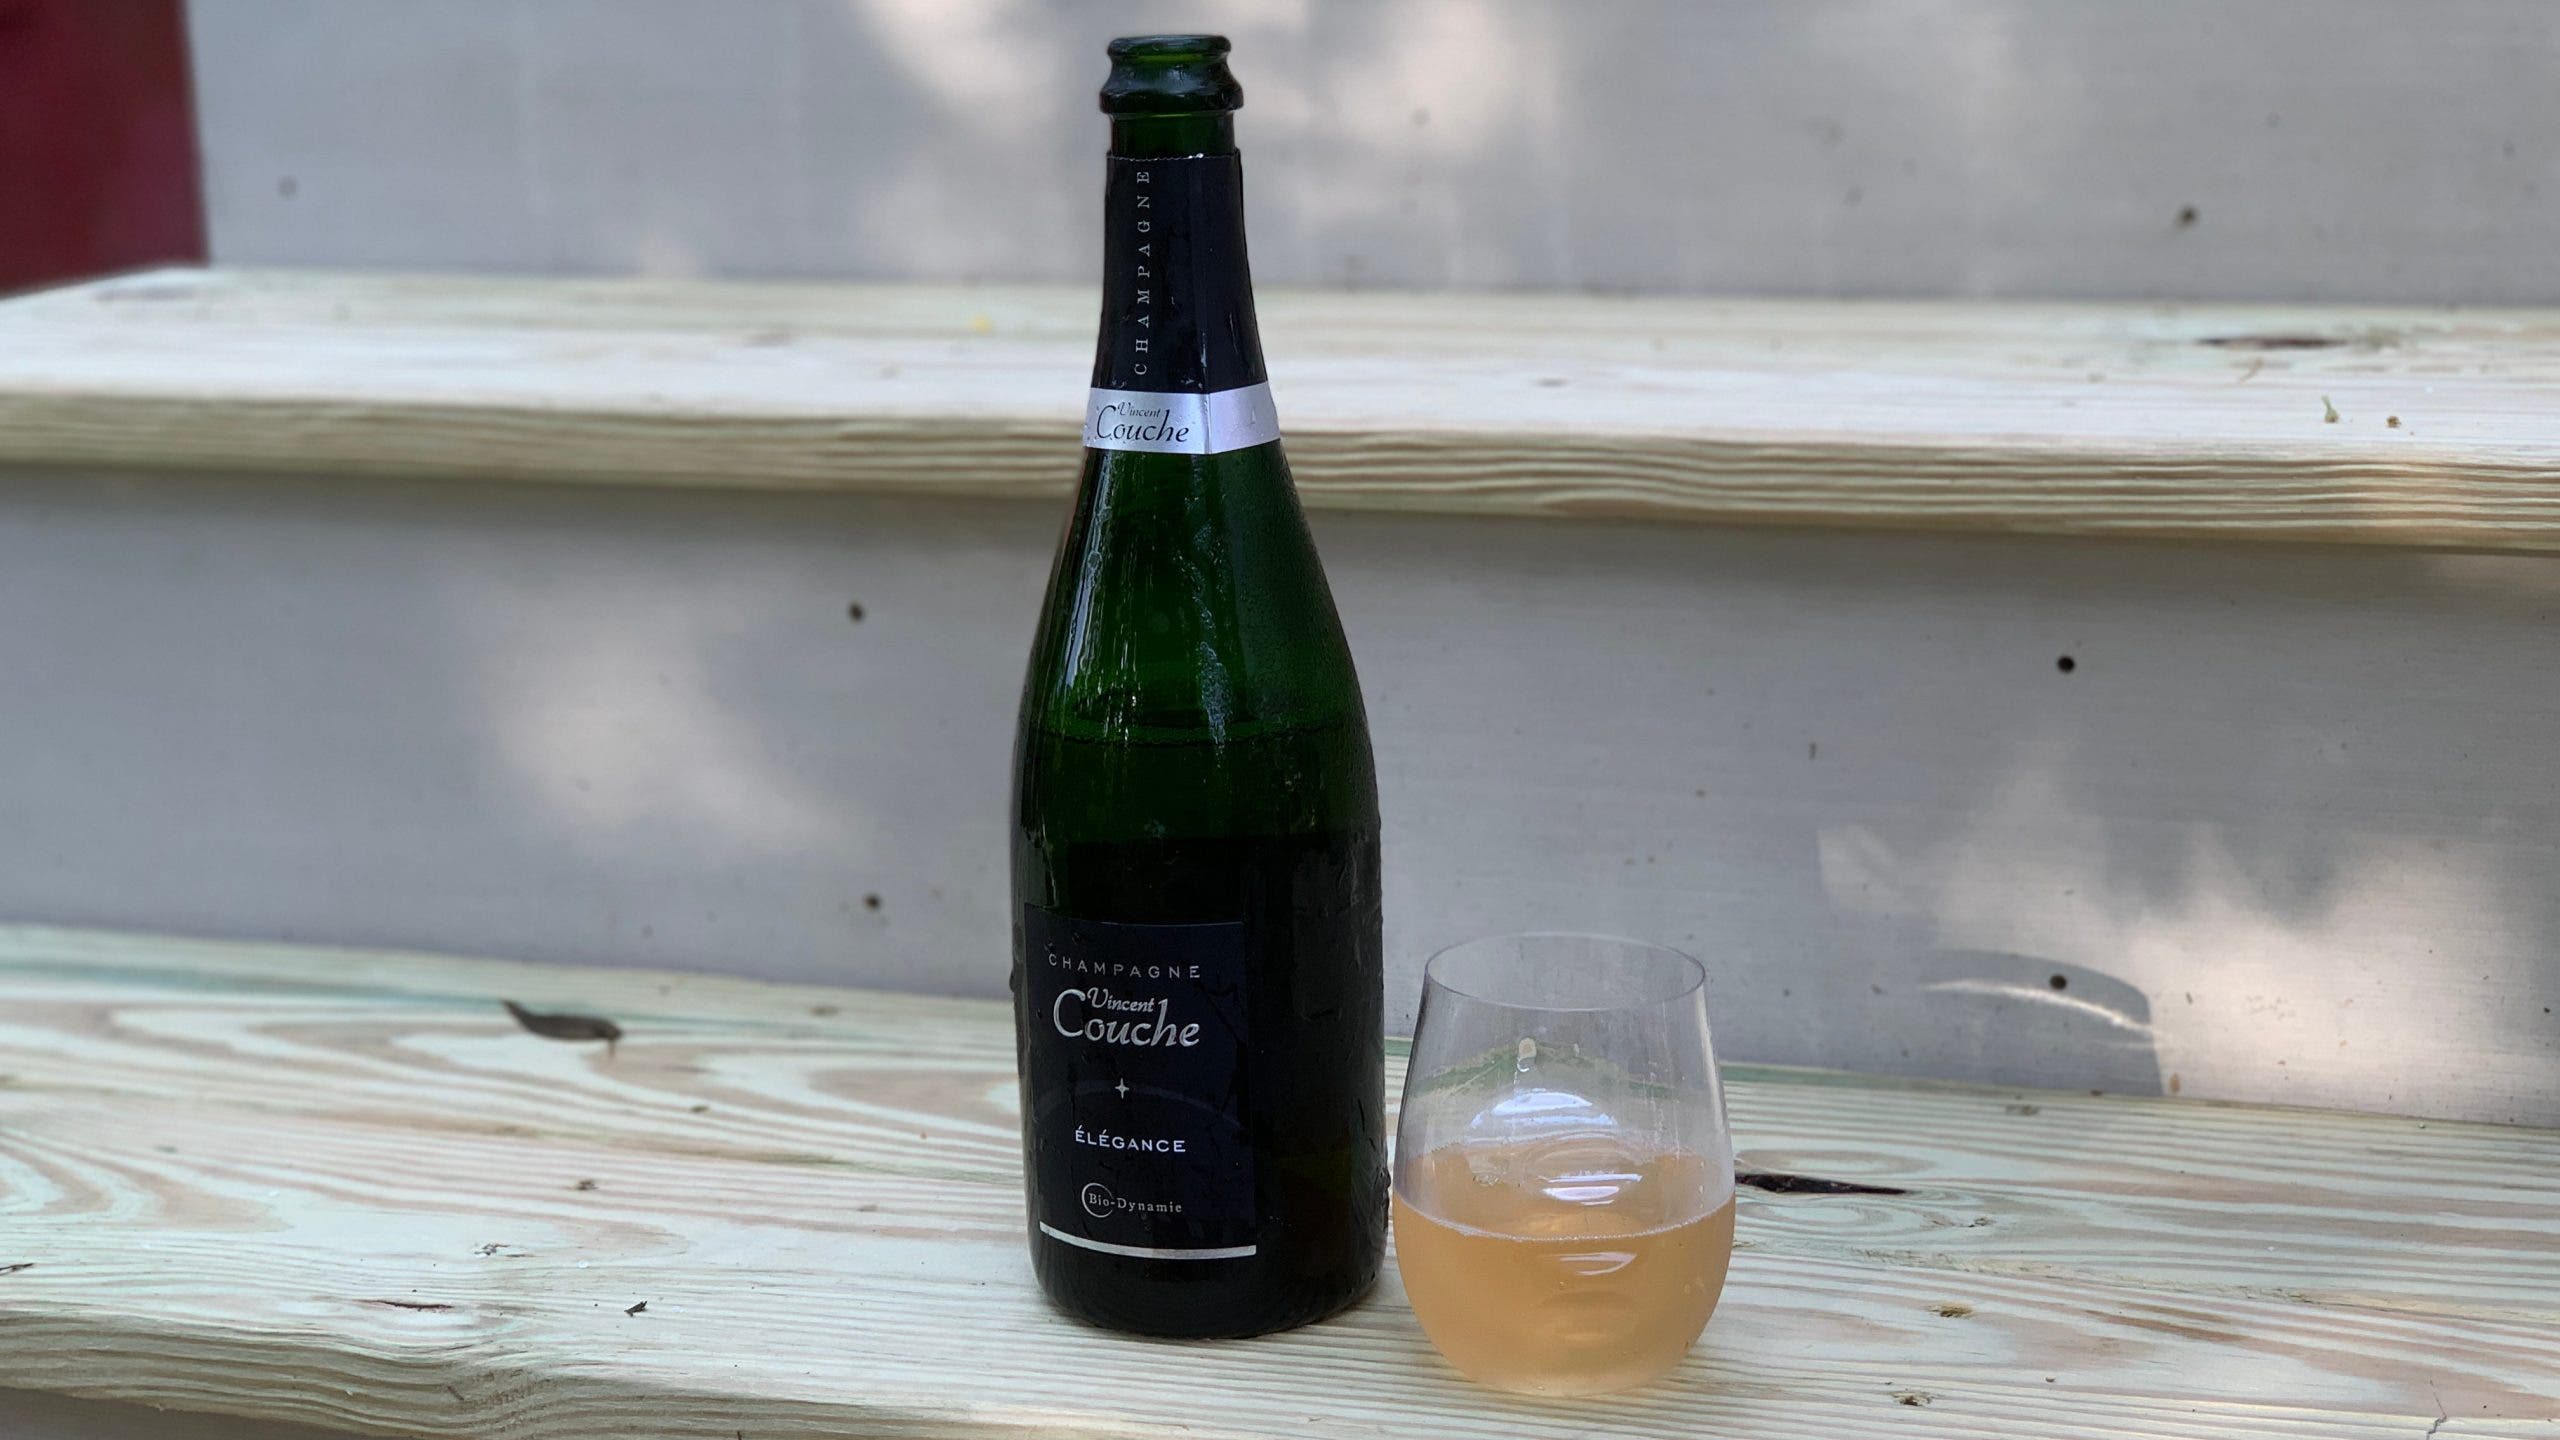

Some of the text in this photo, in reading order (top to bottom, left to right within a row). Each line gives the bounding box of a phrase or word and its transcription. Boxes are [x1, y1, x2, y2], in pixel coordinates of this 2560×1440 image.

[1134, 171, 1150, 376] CHAMPAGNE
[1097, 405, 1189, 442] Couche
[1117, 402, 1161, 418] Vincent
[1049, 953, 1200, 979] CHAMPAGNE
[1087, 987, 1155, 1013] Vincent
[1053, 988, 1200, 1047] Couche
[1075, 1125, 1186, 1152] ÉLÉGANCE
